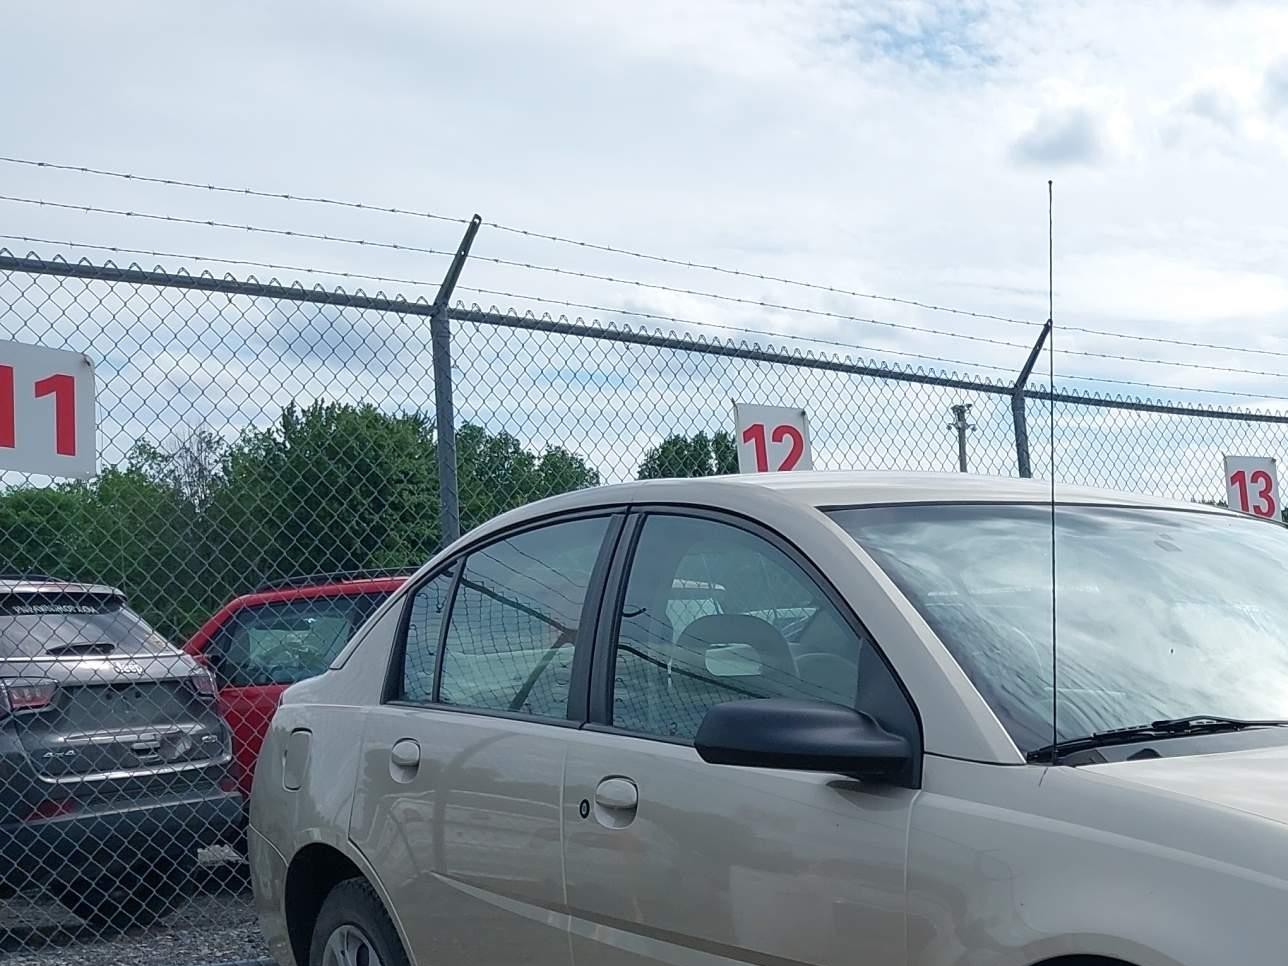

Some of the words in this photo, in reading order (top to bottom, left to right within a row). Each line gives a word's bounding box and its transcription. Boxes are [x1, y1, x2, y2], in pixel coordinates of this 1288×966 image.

[742, 423, 804, 473] 12
[1230, 470, 1275, 518] 13
[114, 662, 145, 676] Jeep
